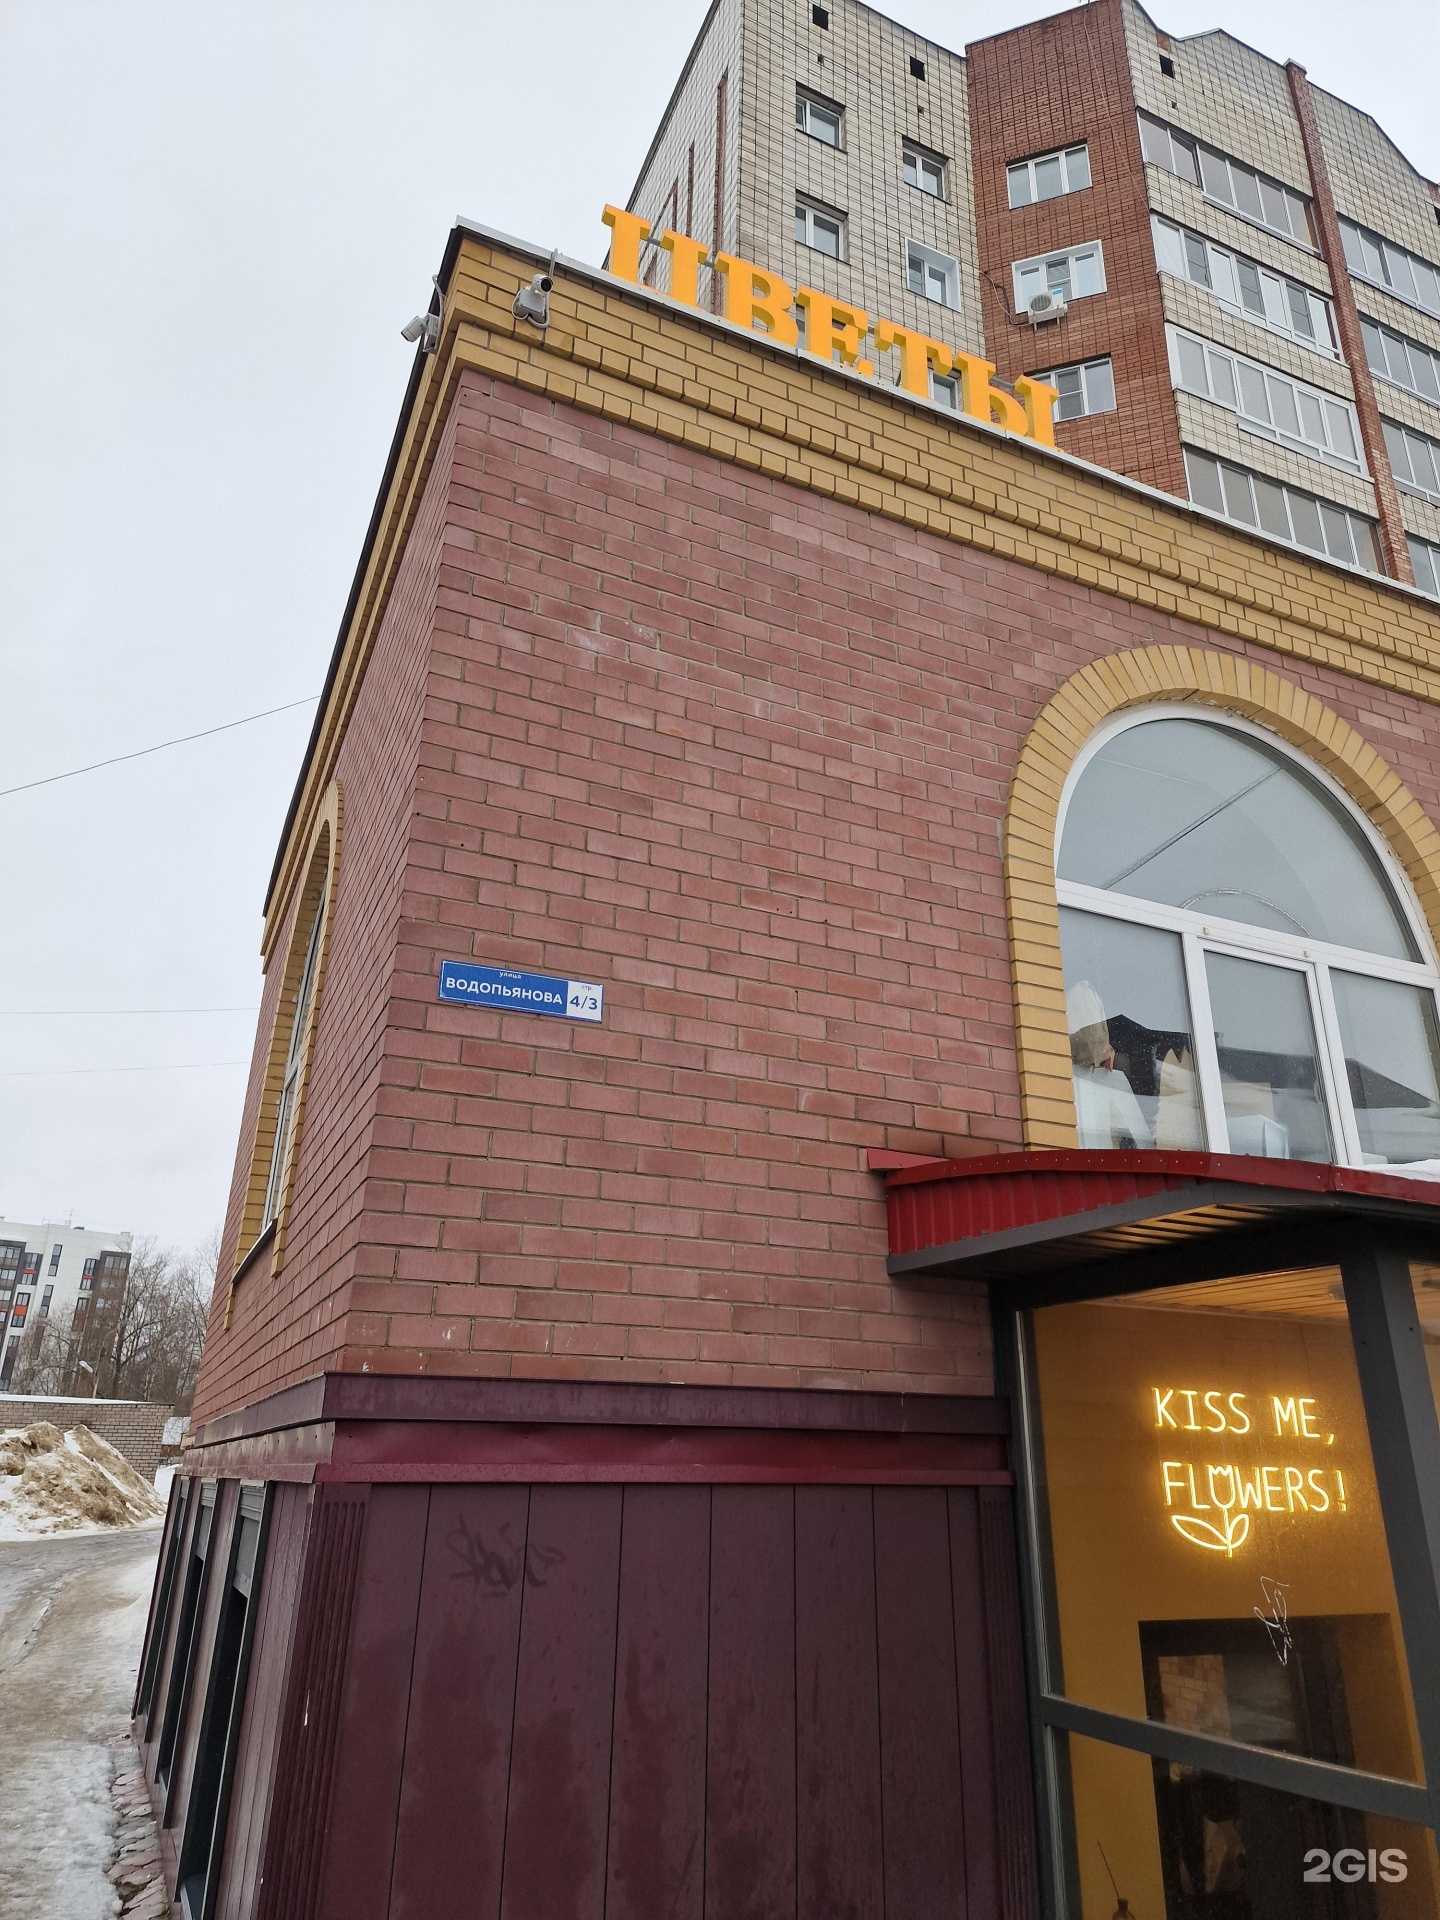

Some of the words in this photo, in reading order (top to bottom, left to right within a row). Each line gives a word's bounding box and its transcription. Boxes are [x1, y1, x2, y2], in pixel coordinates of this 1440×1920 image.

[601, 203, 1058, 449] ЦВЕТЫ
[445, 976, 563, 1005] ВОДОПЬЯНОВА
[569, 995, 598, 1010] 4/3
[1151, 1386, 1250, 1434] KISS
[1272, 1395, 1336, 1446] ME,
[1160, 1460, 1347, 1513] FLOWERS!
